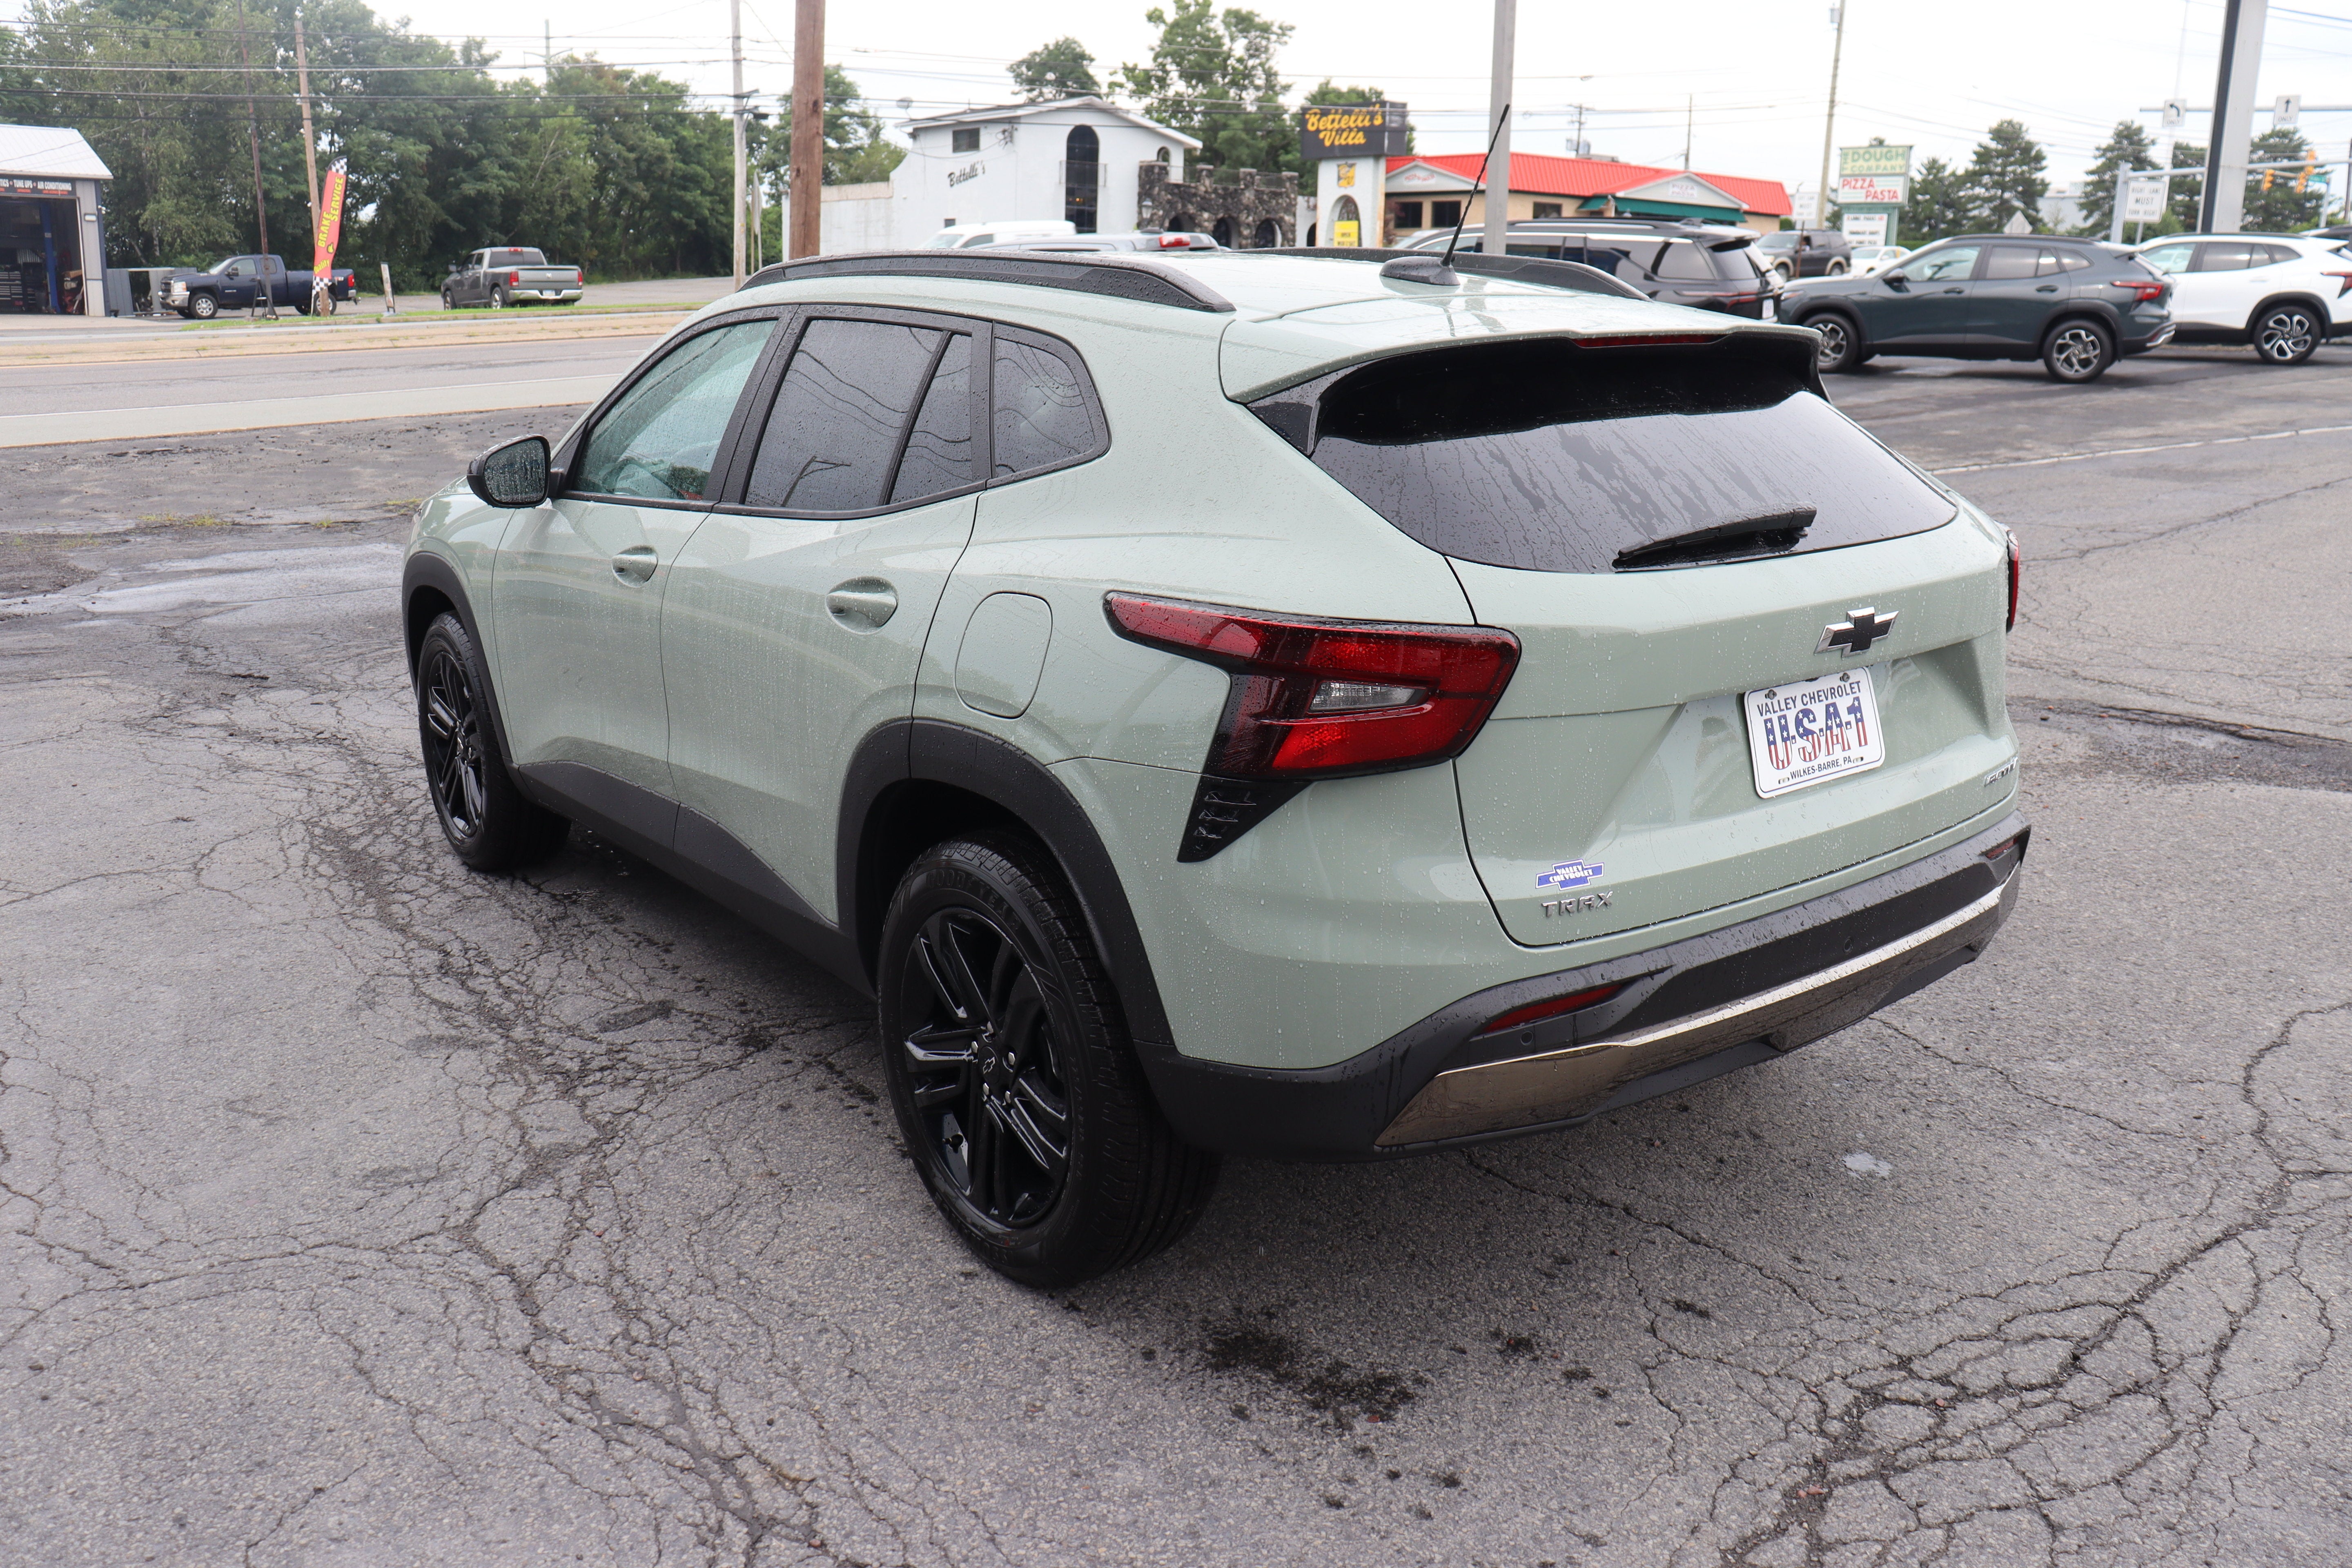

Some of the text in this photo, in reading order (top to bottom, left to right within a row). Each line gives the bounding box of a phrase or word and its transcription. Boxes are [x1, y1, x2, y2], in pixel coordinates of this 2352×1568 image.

[1305, 104, 1383, 131] Bettelli's
[1319, 127, 1367, 147] Villa
[1851, 150, 1906, 162] DOUGH
[1851, 164, 1903, 172] COMPANY
[13, 179, 24, 188] TUNE
[24, 180, 33, 189] UPS
[45, 182, 72, 191] CONDITIONING
[1842, 178, 1875, 189] PIZZA
[330, 176, 344, 222] SERVICE
[1865, 189, 1899, 200] PASTA
[317, 211, 331, 248] BRAKE
[1757, 681, 1861, 717] VALLEY CHEVROLET
[1790, 755, 1852, 780] WILKES-BARRE, PA
[1549, 869, 1593, 882] CHEVROLET
[1556, 865, 1582, 875] VALLEY
[1542, 891, 1613, 917] TRAX
